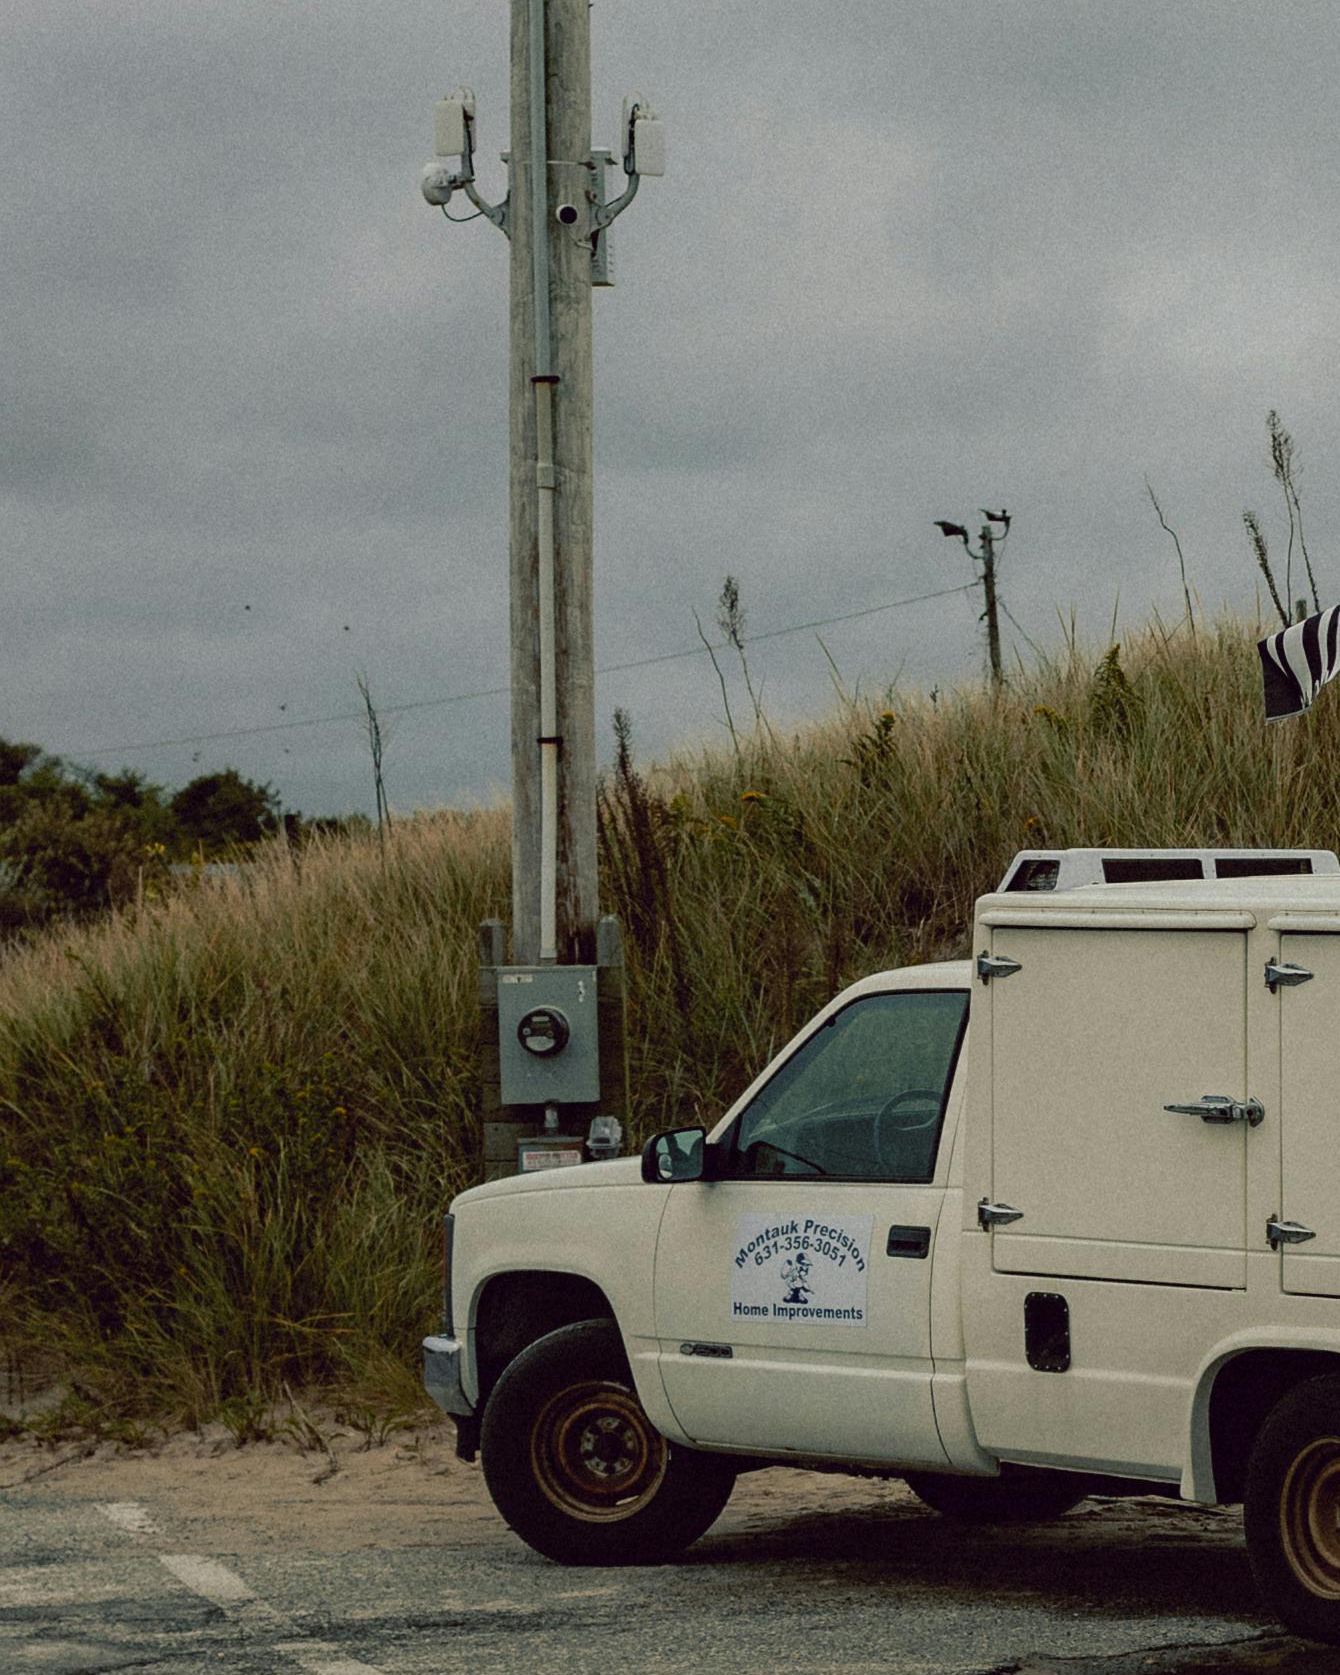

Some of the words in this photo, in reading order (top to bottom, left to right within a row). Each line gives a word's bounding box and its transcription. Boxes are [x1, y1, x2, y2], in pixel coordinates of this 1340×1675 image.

[734, 1220, 799, 1269] Montauk
[803, 1219, 866, 1273] Precision
[754, 1235, 847, 1268] 631-356-3051
[733, 1301, 769, 1316] Home
[773, 1303, 863, 1320] Improvements
